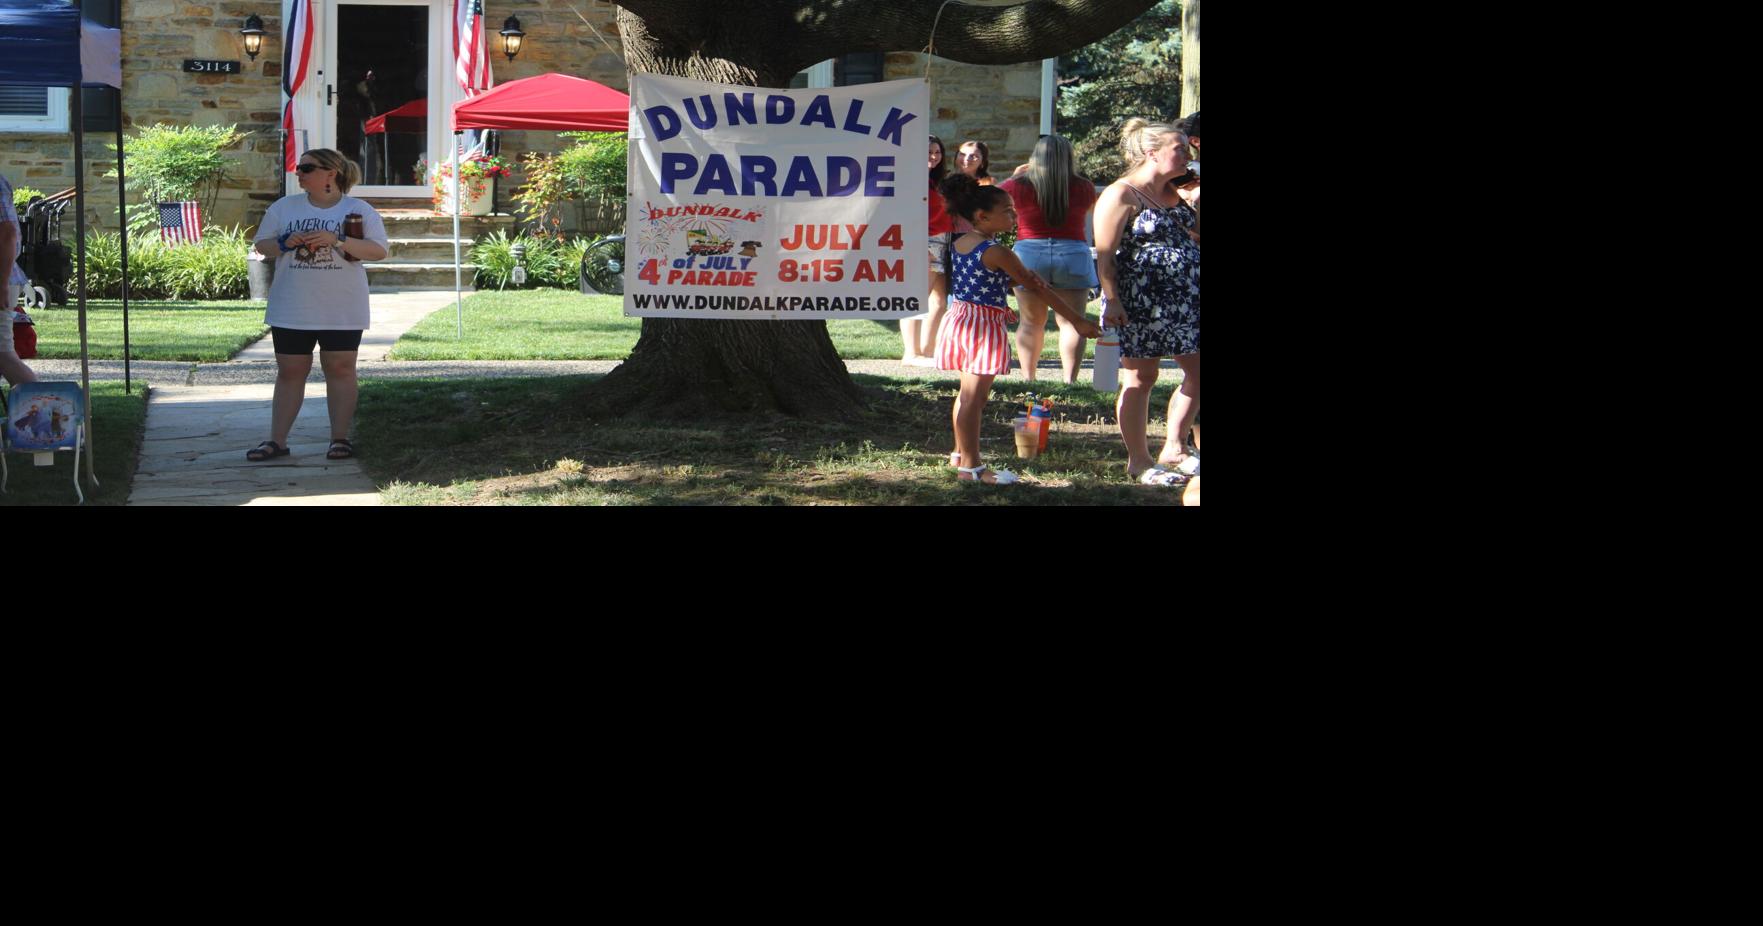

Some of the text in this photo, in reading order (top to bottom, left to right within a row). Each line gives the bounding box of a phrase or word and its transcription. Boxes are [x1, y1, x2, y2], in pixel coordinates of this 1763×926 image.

[190, 61, 232, 72] 3114
[643, 92, 918, 147] DUNDALK
[660, 152, 896, 198] PARADE
[648, 204, 763, 223] DUNDALK
[285, 217, 342, 235] AMERICA
[779, 223, 904, 251] JULY 4
[672, 255, 697, 270] of
[699, 255, 753, 271] JULY
[777, 258, 905, 283] 8:15 AM
[666, 269, 758, 287] PARADE
[632, 294, 920, 312] WWW.DUNDALKPARADE.ORG
